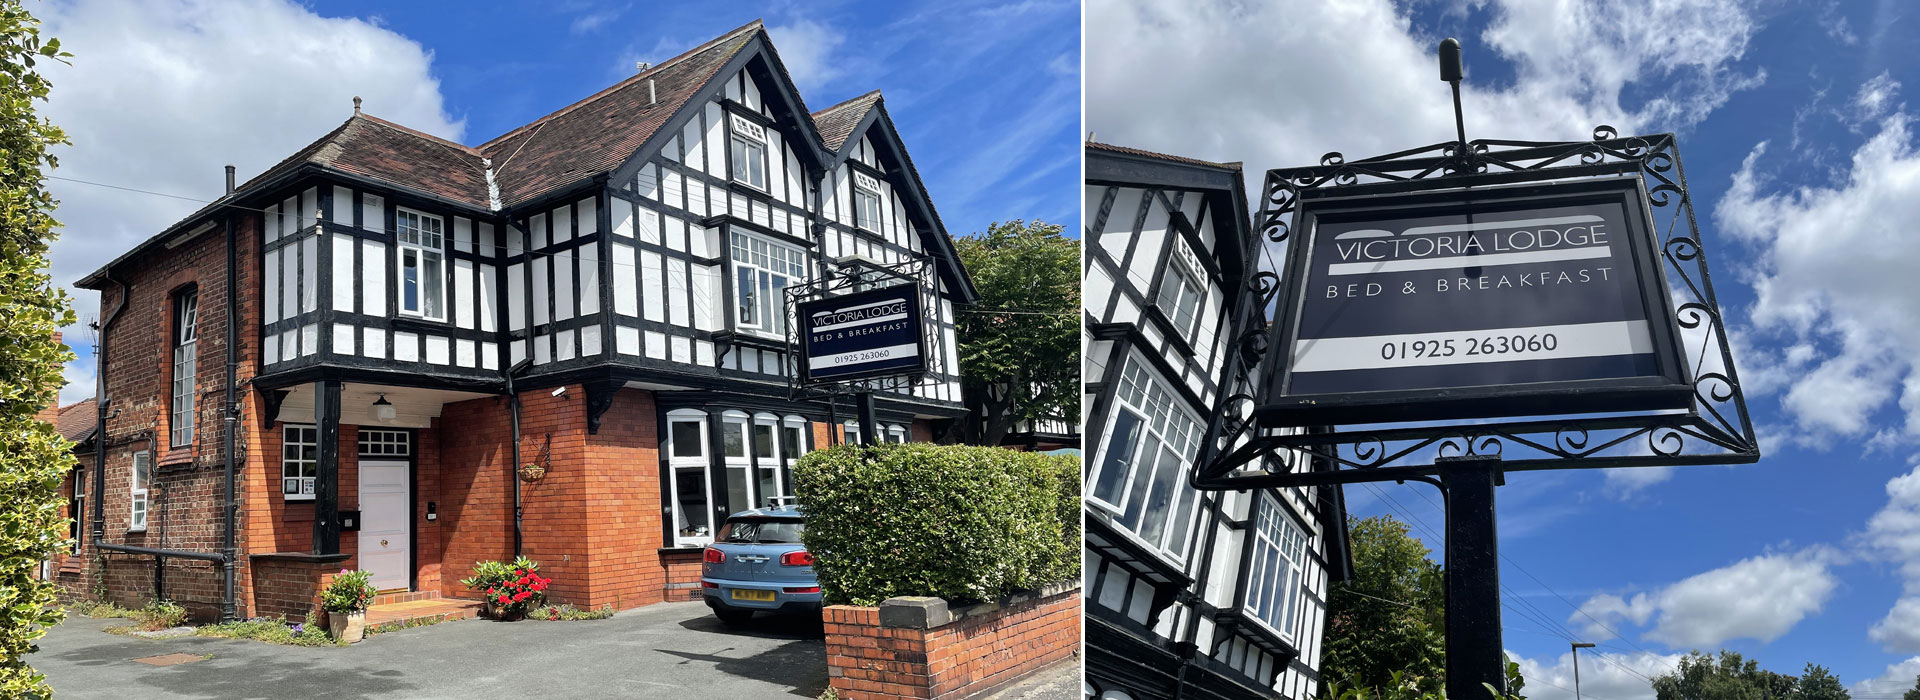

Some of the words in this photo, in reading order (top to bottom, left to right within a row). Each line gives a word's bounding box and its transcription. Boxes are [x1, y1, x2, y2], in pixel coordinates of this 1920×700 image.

[1336, 234, 1485, 261] VICTORIA
[1494, 224, 1609, 251] LODGE
[1326, 282, 1382, 299] BED
[1402, 281, 1417, 294] &
[1437, 267, 1612, 292] BREAKFAST
[813, 310, 864, 327] VICTORIA
[866, 303, 907, 318] LODGE
[813, 334, 832, 343] BED
[849, 322, 908, 337] BREAKFAST
[834, 355, 858, 364] 01925
[860, 349, 890, 361] 263060
[1381, 339, 1456, 360] 01925
[1465, 333, 1558, 356] 263060
